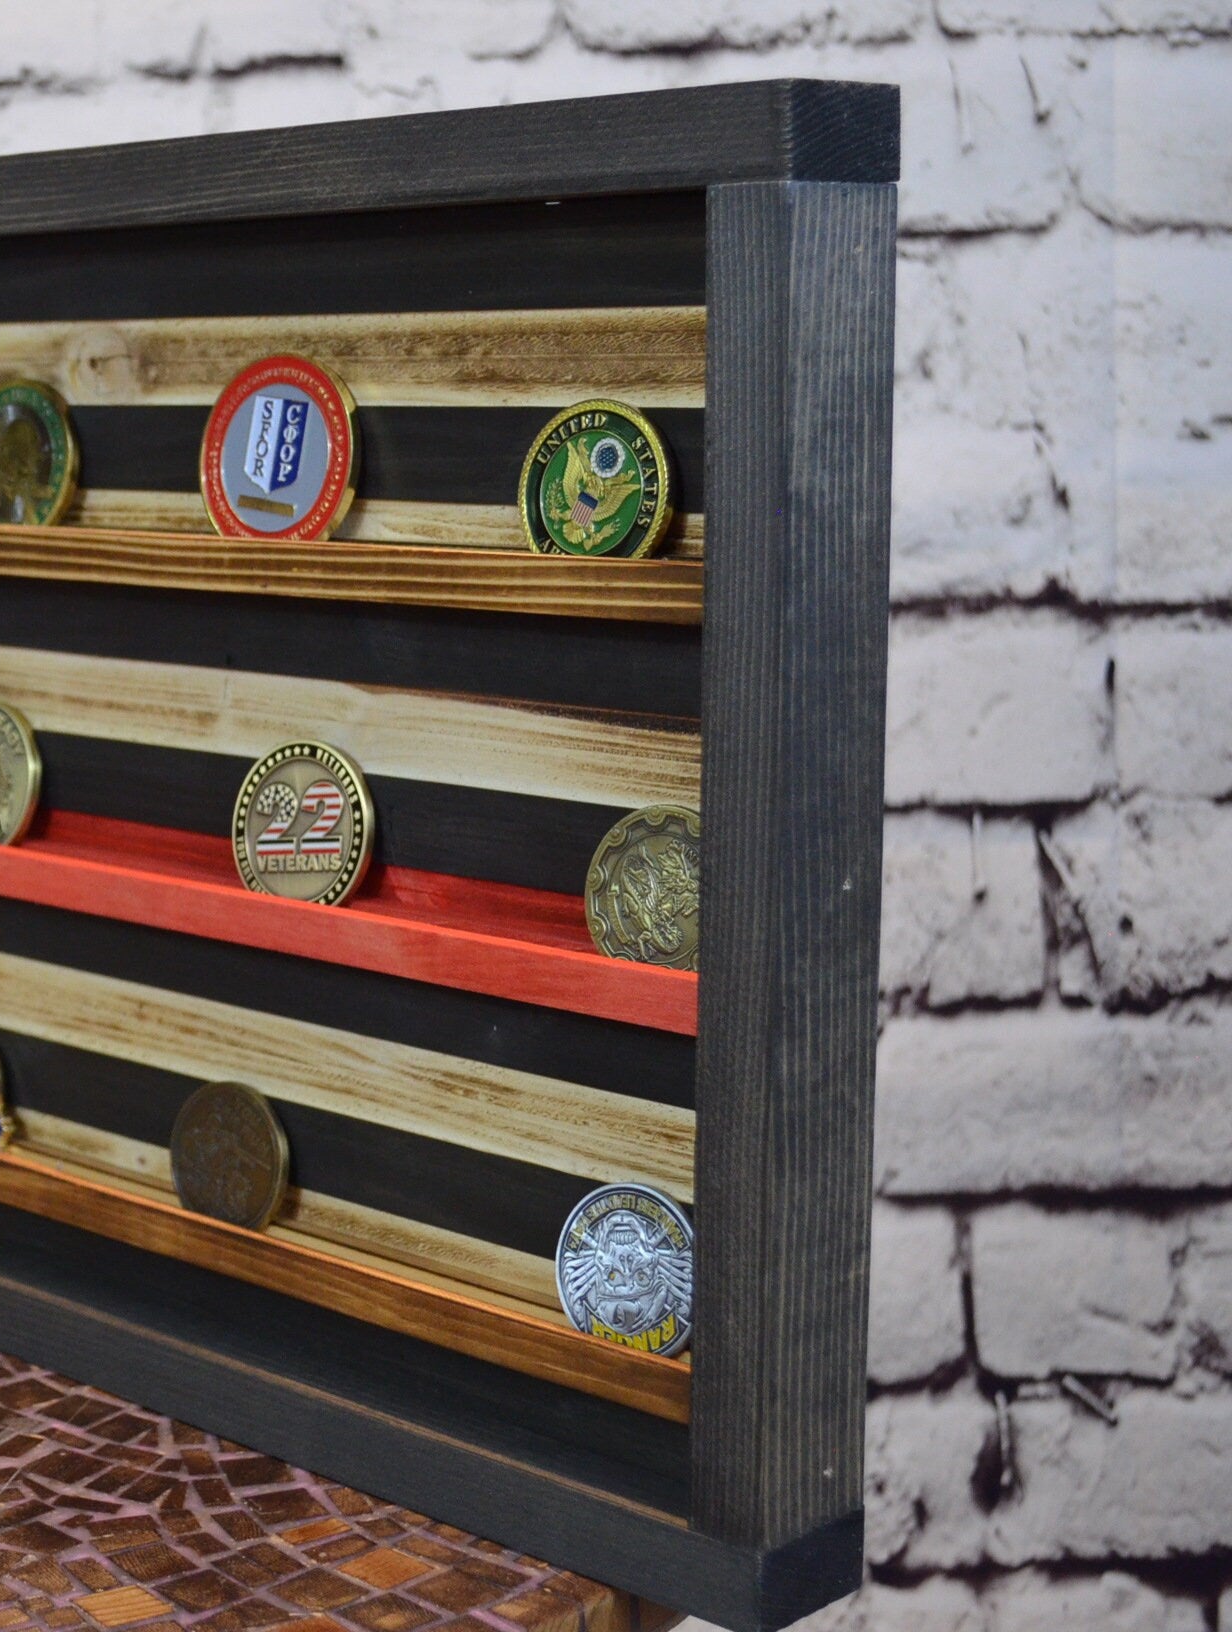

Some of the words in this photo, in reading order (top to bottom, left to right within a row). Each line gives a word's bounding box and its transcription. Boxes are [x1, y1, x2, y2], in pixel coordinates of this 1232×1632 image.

[252, 400, 274, 478] SFOR
[536, 413, 608, 464] UNITED
[632, 436, 657, 528] STATES
[256, 781, 343, 855] 22
[256, 854, 342, 873] VETERANS
